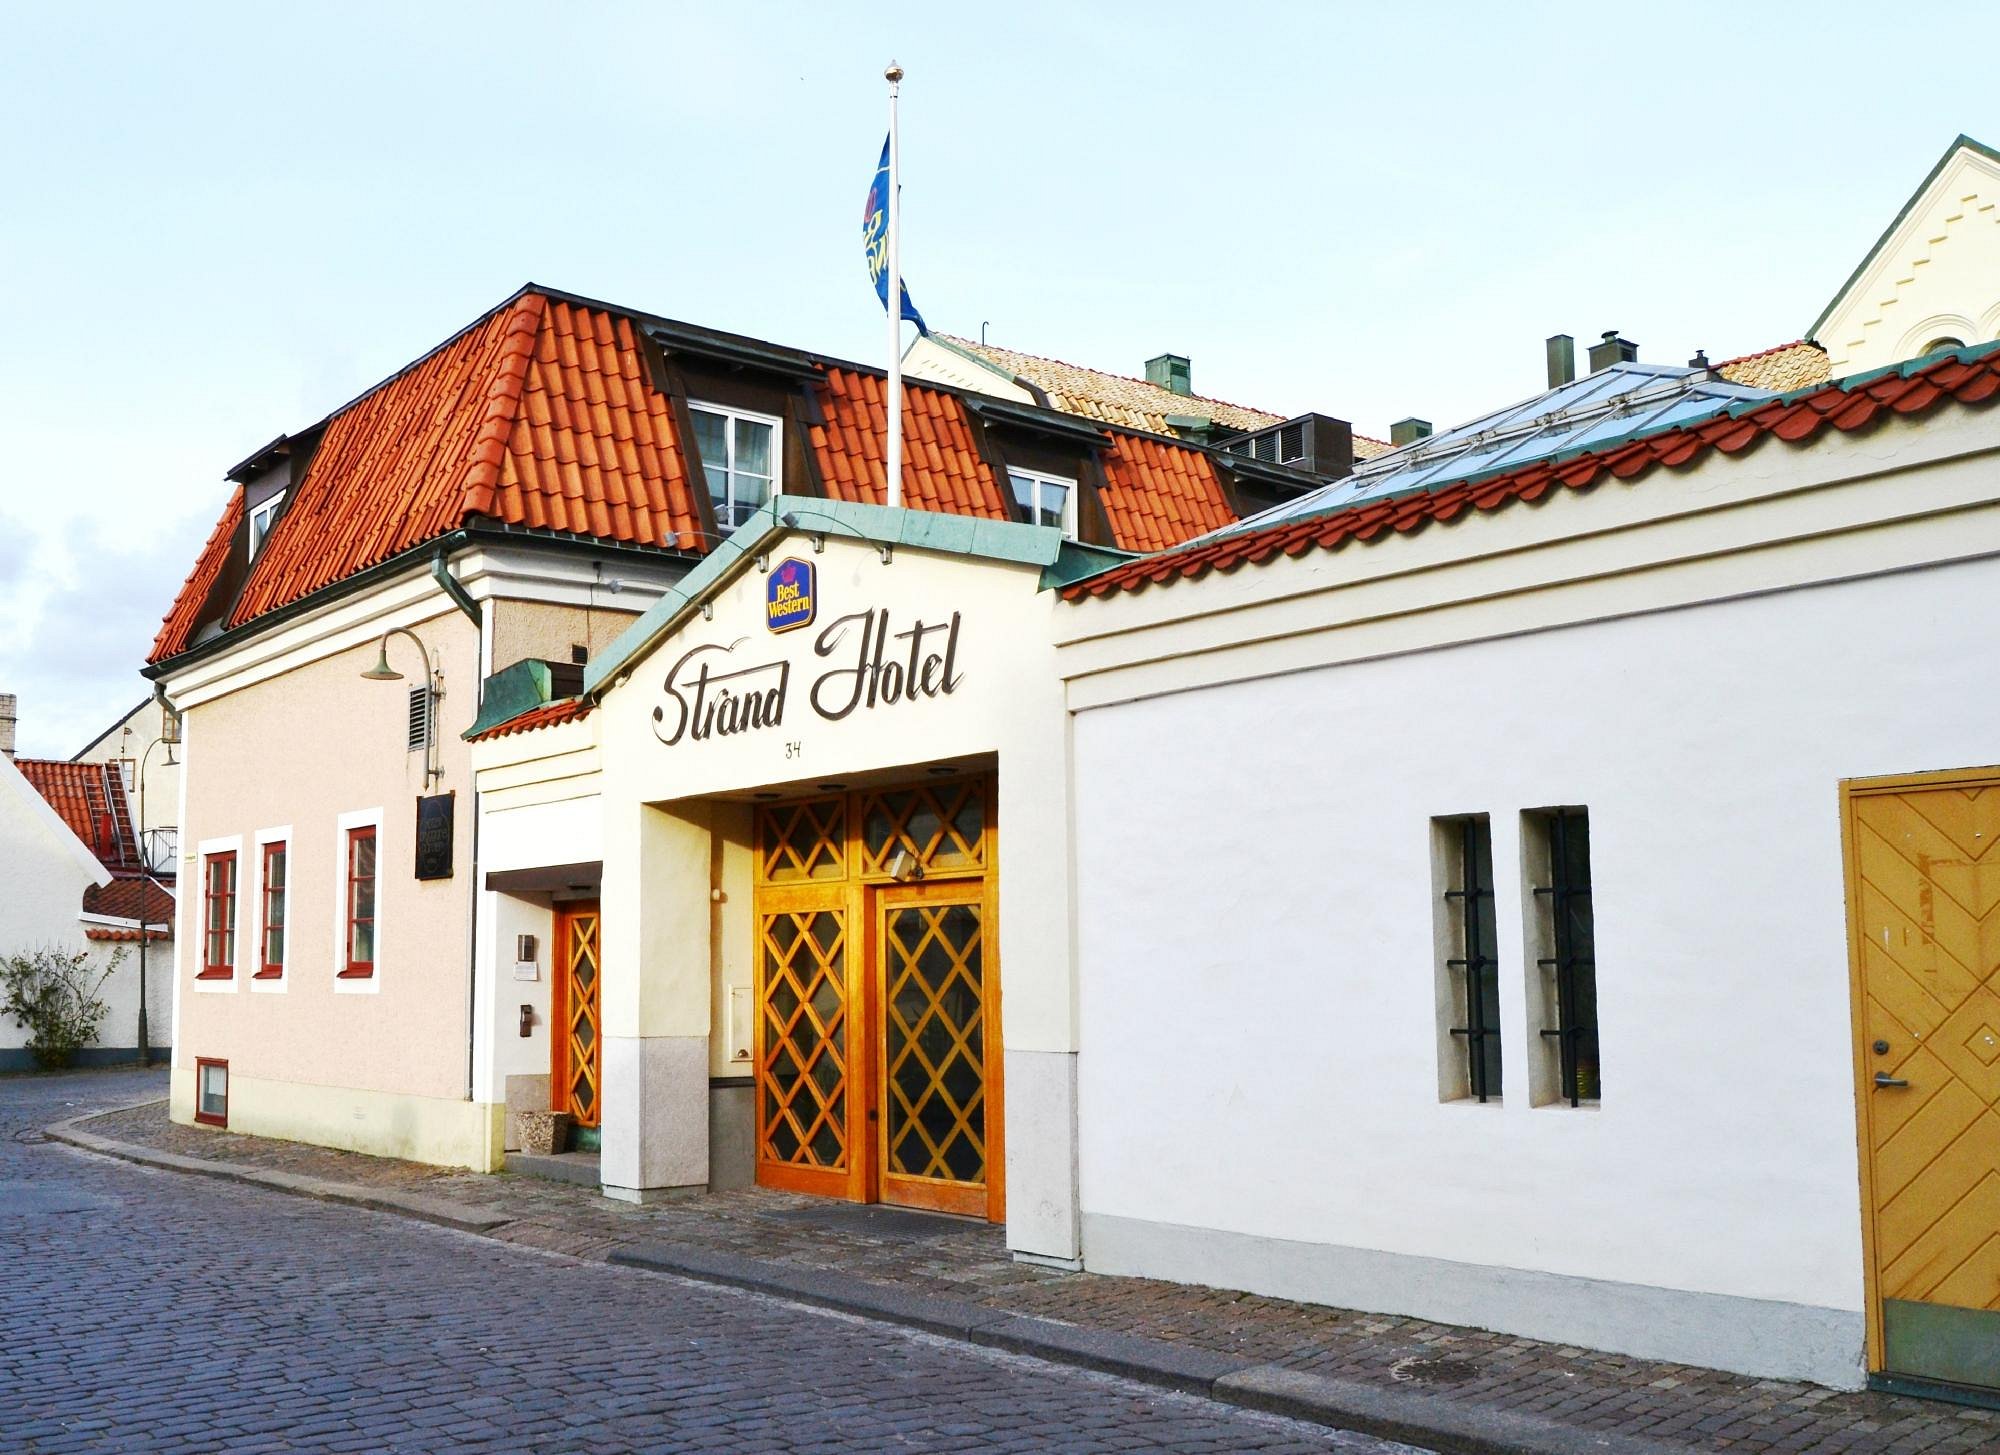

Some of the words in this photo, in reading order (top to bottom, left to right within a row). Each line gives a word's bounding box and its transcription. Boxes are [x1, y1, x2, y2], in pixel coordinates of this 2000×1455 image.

[777, 580, 800, 602] Best
[768, 596, 810, 619] Western
[652, 636, 790, 746] Strand
[810, 607, 965, 721] Hotel
[785, 740, 802, 760] 34
